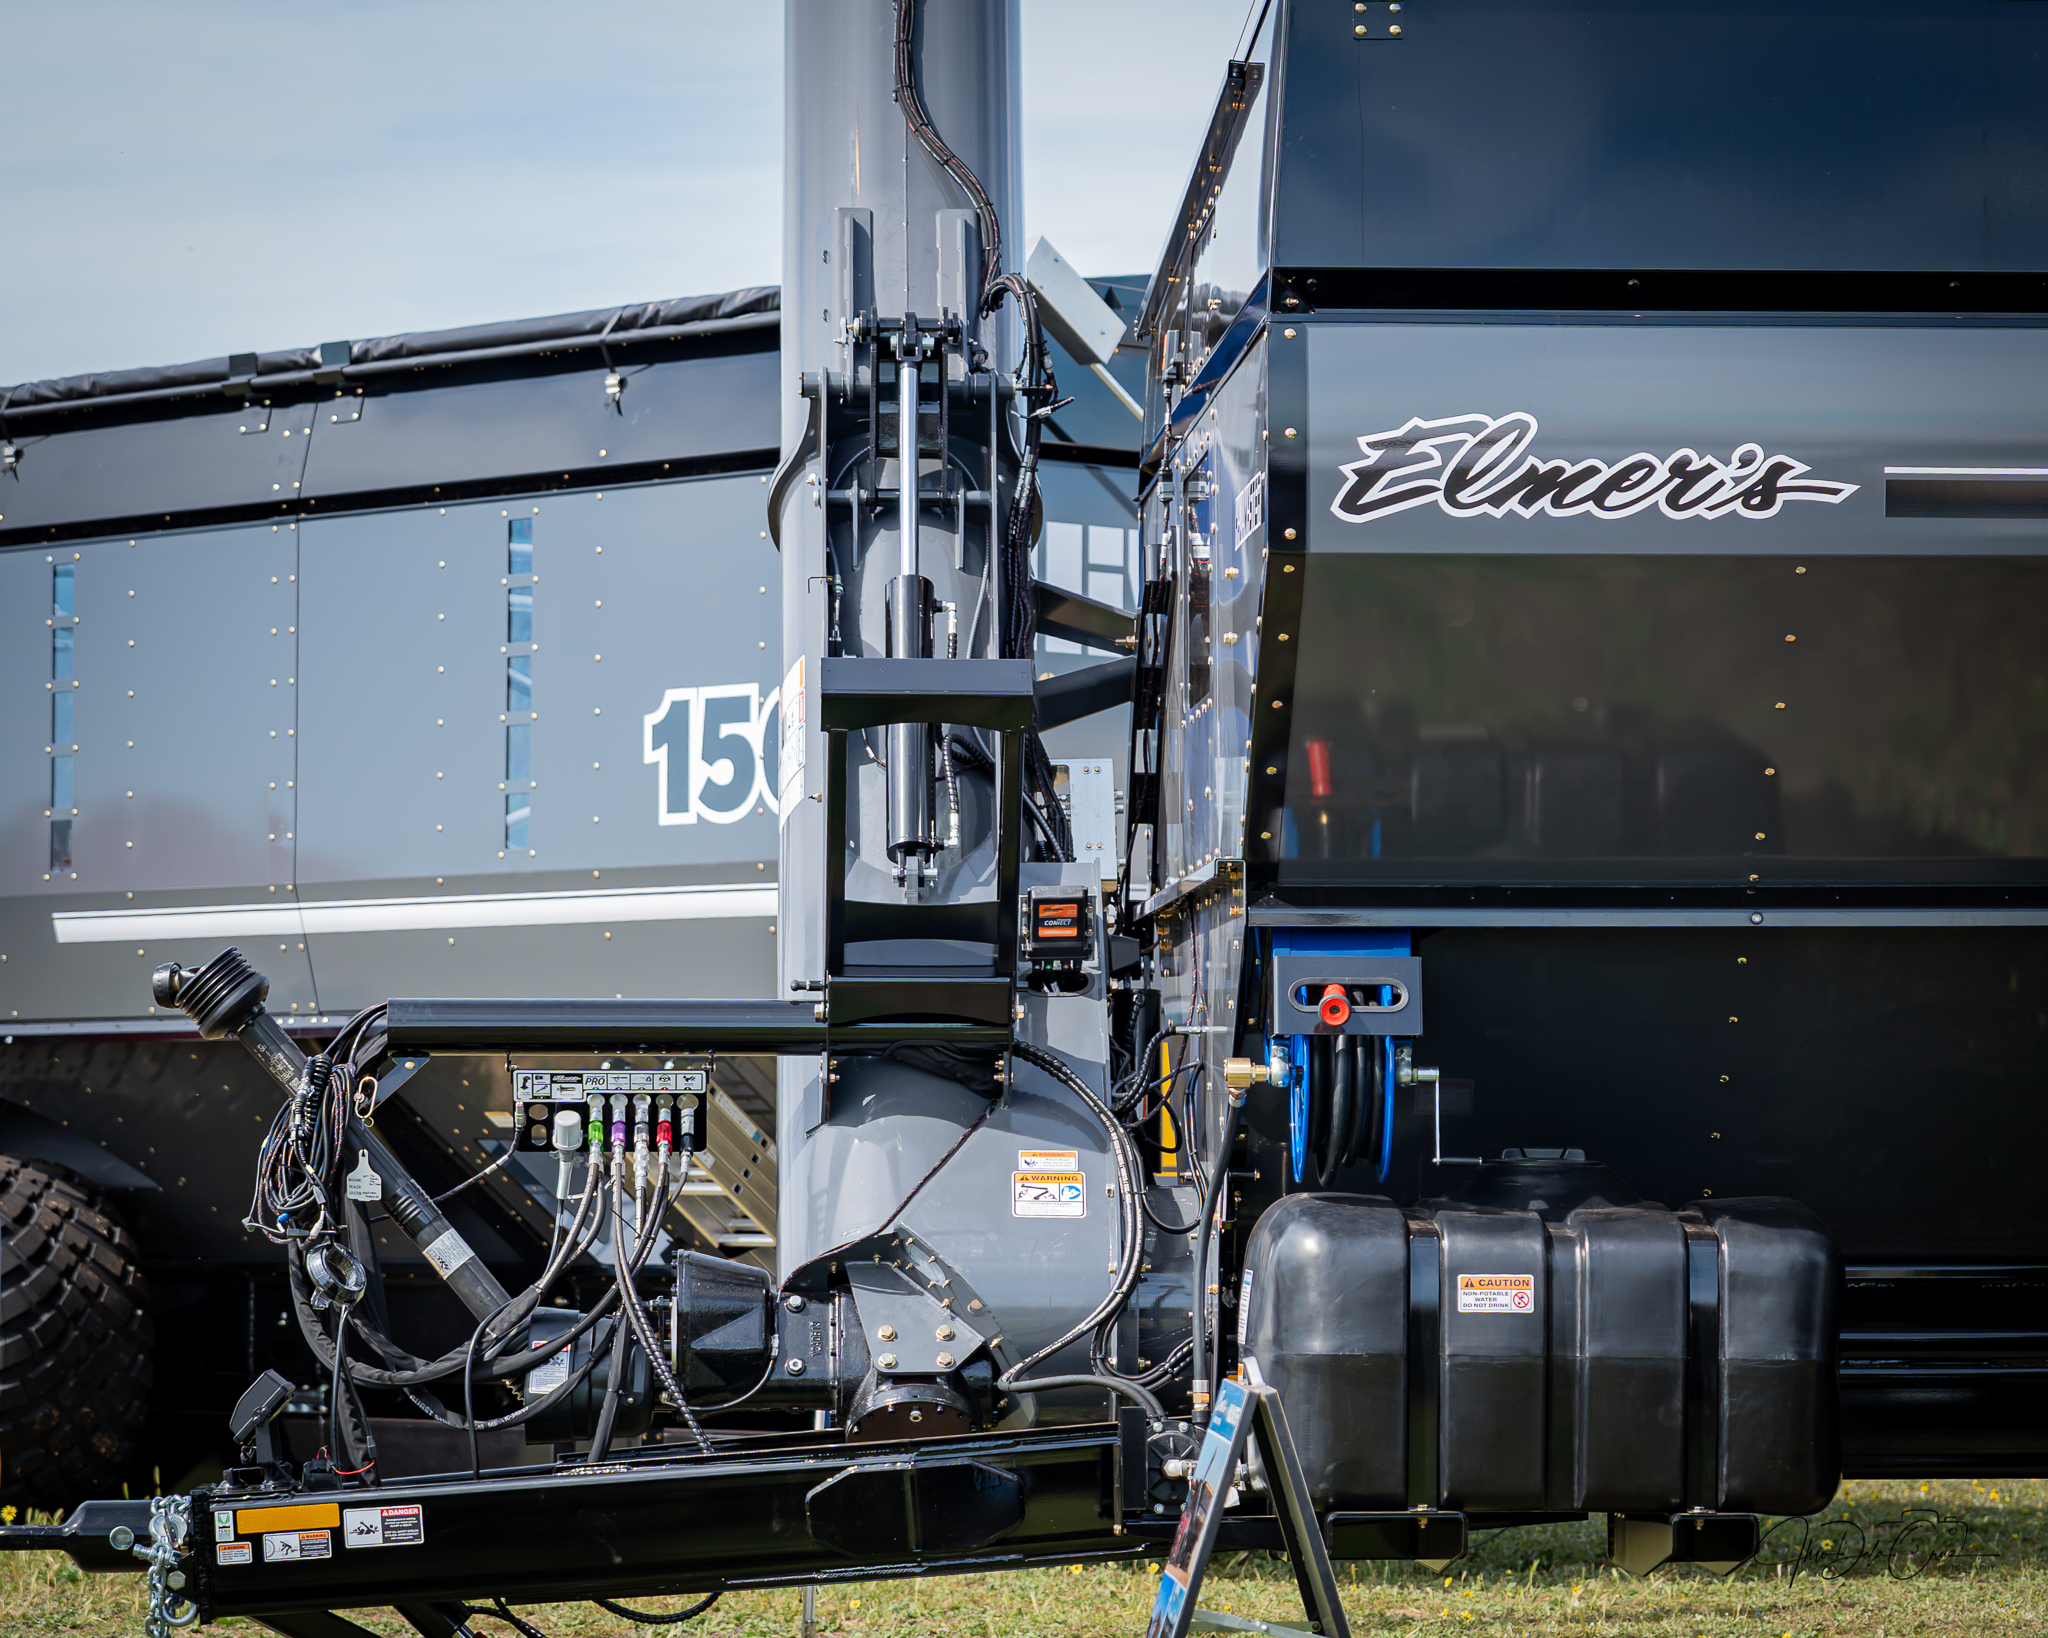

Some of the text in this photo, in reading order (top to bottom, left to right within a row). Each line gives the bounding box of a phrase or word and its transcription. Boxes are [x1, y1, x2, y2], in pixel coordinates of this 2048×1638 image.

[1330, 411, 1861, 523] Elmer's
[584, 1077, 605, 1085] PRO
[1478, 1279, 1530, 1287] CAUTION
[388, 1508, 419, 1516] DANGER
